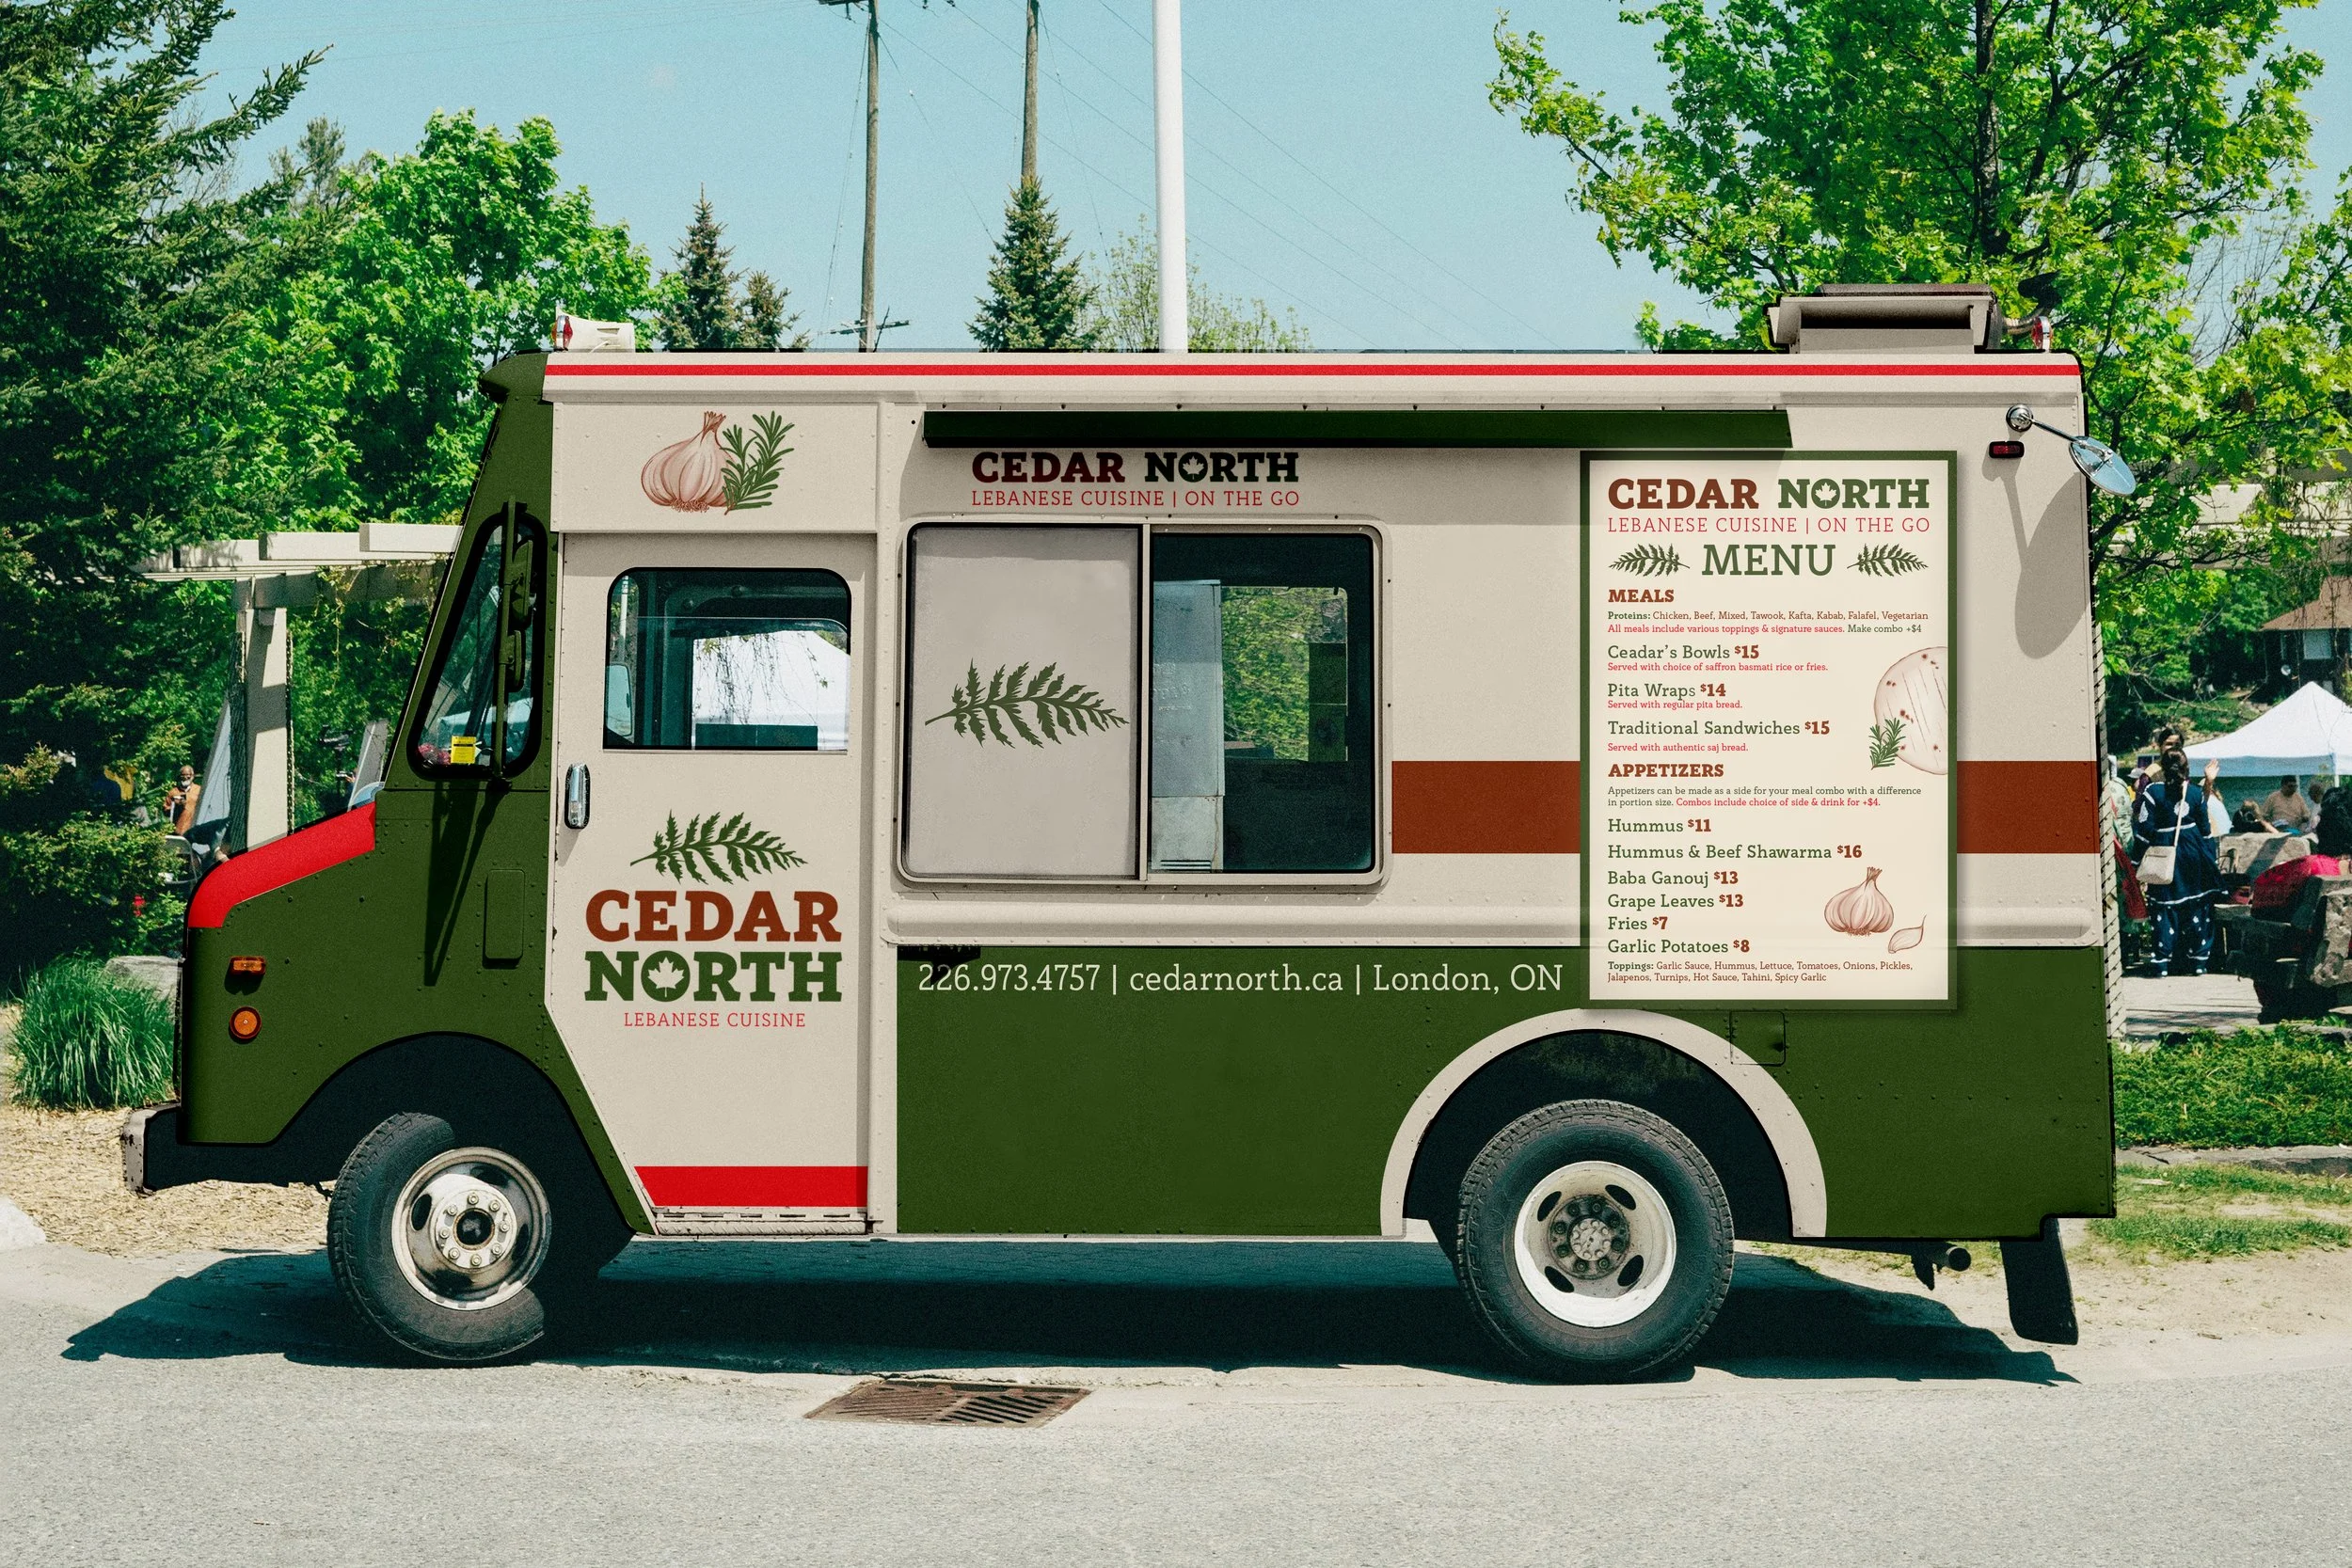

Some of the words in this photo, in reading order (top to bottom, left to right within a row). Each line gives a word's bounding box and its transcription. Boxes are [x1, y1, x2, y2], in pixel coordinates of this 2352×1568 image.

[971, 451, 1126, 483] CEDAR
[1145, 451, 1300, 483] NORTH
[972, 490, 1073, 506] LEBANESE
[1081, 490, 1164, 506] CUISINE
[1185, 490, 1215, 506] ON
[1223, 490, 1263, 506] THE
[1270, 491, 1299, 506] GO
[1608, 478, 1759, 510] CEDAR
[1778, 478, 1930, 509] NORTH
[1608, 517, 1708, 532] LEBANESE
[1716, 517, 1797, 532] CUISINE
[1818, 517, 1847, 532] ON
[1855, 517, 1894, 532] THE
[1901, 517, 1930, 532] GO
[1701, 544, 1836, 577] MENU
[1608, 589, 1675, 603] MEALS
[1608, 610, 1651, 620] Proteins:
[1652, 610, 1692, 620] Chicken,
[1693, 610, 1715, 620] Beef,
[1718, 610, 1748, 620] Mixed,
[1750, 610, 1786, 620] Tawook,
[1788, 610, 1814, 620] Kafta,
[1817, 610, 1846, 620] Kabab,
[1848, 610, 1879, 620] Falafel,
[1882, 610, 1929, 622] Vegetarian
[1607, 624, 1621, 633] All
[1624, 624, 1650, 633] meals
[1652, 624, 1685, 633] include
[1687, 625, 1720, 633] various
[1722, 625, 1759, 635] toppings
[1761, 624, 1769, 633] &
[1771, 625, 1812, 635] signature
[1847, 624, 1872, 633] Make
[1873, 624, 1903, 633] combo
[1906, 624, 1922, 633] +$4
[1682, 644, 1730, 658] Bowls
[1734, 644, 1759, 659] $15
[1608, 662, 1638, 671] Served
[1640, 662, 1661, 671] with
[1662, 662, 1692, 671] choice
[1693, 662, 1704, 671] of
[1705, 662, 1736, 671] saffron
[1739, 662, 1773, 671] basmati
[1806, 662, 1828, 671] fries.
[1608, 683, 1639, 697] Pita
[1644, 683, 1695, 702] Wraps
[1700, 683, 1726, 697] $14
[1608, 700, 1638, 708] Served
[1640, 700, 1661, 708] with
[1663, 700, 1694, 711] regular
[1696, 701, 1713, 711] pita
[1715, 700, 1742, 708] bread.
[1608, 720, 1698, 735] Traditional
[1705, 721, 1800, 735] Sandwiches
[1804, 721, 1830, 735] $15
[1608, 742, 1638, 752] Served
[1640, 742, 1661, 752] with
[1662, 742, 1705, 752] authentic
[1708, 743, 1719, 753] saj
[1721, 742, 1748, 752] bread.
[1608, 764, 1724, 777] APPETIZERS
[1608, 786, 1655, 797] Appetizers
[1675, 786, 1686, 795] be
[1688, 786, 1712, 795] made
[1734, 786, 1752, 795] side
[1754, 785, 1767, 795] for
[1769, 788, 1789, 797] your
[1791, 785, 1813, 795] meal
[1815, 786, 1845, 795] combo
[1847, 786, 1867, 795] with
[1877, 785, 1921, 795] difference
[1619, 799, 1653, 808] portion
[1676, 798, 1711, 806] Combos
[1714, 798, 1747, 806] include
[1749, 798, 1777, 806] choice
[1779, 798, 1789, 806] of
[1791, 798, 1809, 806] side
[1811, 798, 1819, 806] &
[1820, 798, 1845, 806] drink
[1847, 798, 1860, 806] for
[1863, 798, 1881, 807] +$4.
[1608, 818, 1683, 832] Hummus
[1688, 818, 1711, 832] $11
[1608, 845, 1683, 858] Hummus
[1688, 845, 1700, 858] &
[1706, 844, 1742, 858] Beef
[1747, 844, 1832, 859] Shawarma
[1836, 845, 1863, 858] $16
[1608, 870, 1646, 884] Baba
[1652, 871, 1708, 889] Ganouj
[1713, 871, 1739, 884] $13
[1608, 894, 1656, 911] Grape
[1661, 894, 1714, 908] Leaves
[1719, 894, 1743, 908] $13
[585, 889, 842, 942] CEDAR
[1608, 916, 1647, 930] Fries
[1652, 916, 1668, 930] $7
[1608, 939, 1656, 953] Garlic
[1661, 939, 1728, 953] Potatoes
[1733, 939, 1750, 953] $8
[1607, 961, 1654, 972] Toppings:
[1656, 961, 1682, 970] Garlic
[1685, 961, 1712, 971] Sauce,
[1714, 961, 1757, 971] Hummus,
[1760, 961, 1794, 971] Lettuce,
[1796, 961, 1840, 970] Tomatoes,
[1843, 961, 1878, 971] Onions,
[1880, 961, 1913, 971] Pickles,
[584, 950, 843, 1003] NORTH
[919, 963, 1100, 991] 226.973.4757
[1130, 963, 1343, 991] cedarnorth.ca
[1374, 963, 1499, 994] London,
[1511, 964, 1563, 990] ON
[1607, 973, 1652, 984] Jalapenos,
[1654, 973, 1691, 984] Turnips,
[1693, 973, 1709, 981] Hot
[1712, 973, 1740, 982] Sauce,
[1741, 973, 1772, 982] Tahini,
[1774, 973, 1799, 984] Spicy
[1801, 973, 1827, 981] Garlic
[624, 1012, 720, 1027] LEBANESE
[727, 1012, 805, 1027] CUISINE
